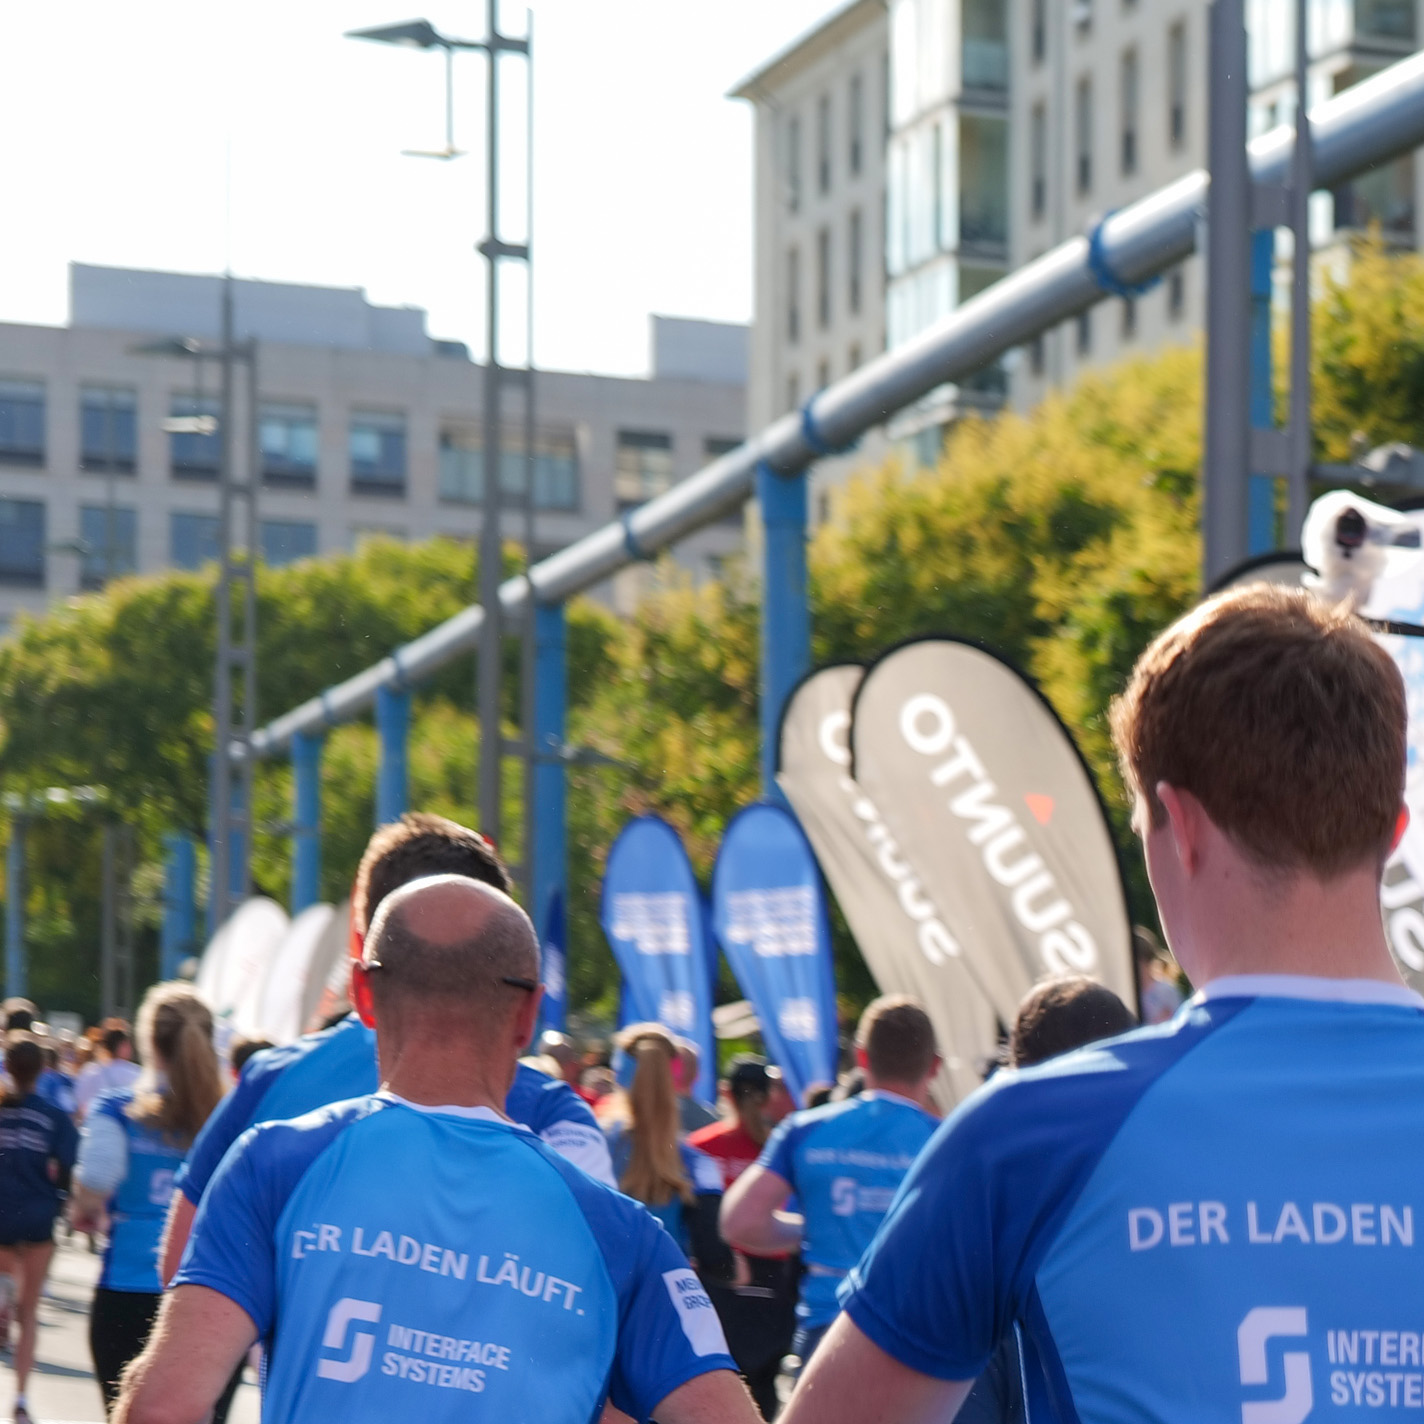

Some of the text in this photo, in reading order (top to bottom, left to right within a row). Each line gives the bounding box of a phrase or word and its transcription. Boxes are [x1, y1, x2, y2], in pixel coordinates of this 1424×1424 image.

[1128, 1201, 1230, 1252] DER
[1247, 1201, 1413, 1247] LADEN
[351, 1227, 468, 1280] LADEN
[477, 1253, 585, 1316] LÄUFT.
[388, 1323, 511, 1371] INTERFACE
[381, 1353, 486, 1392] SYSTEMS
